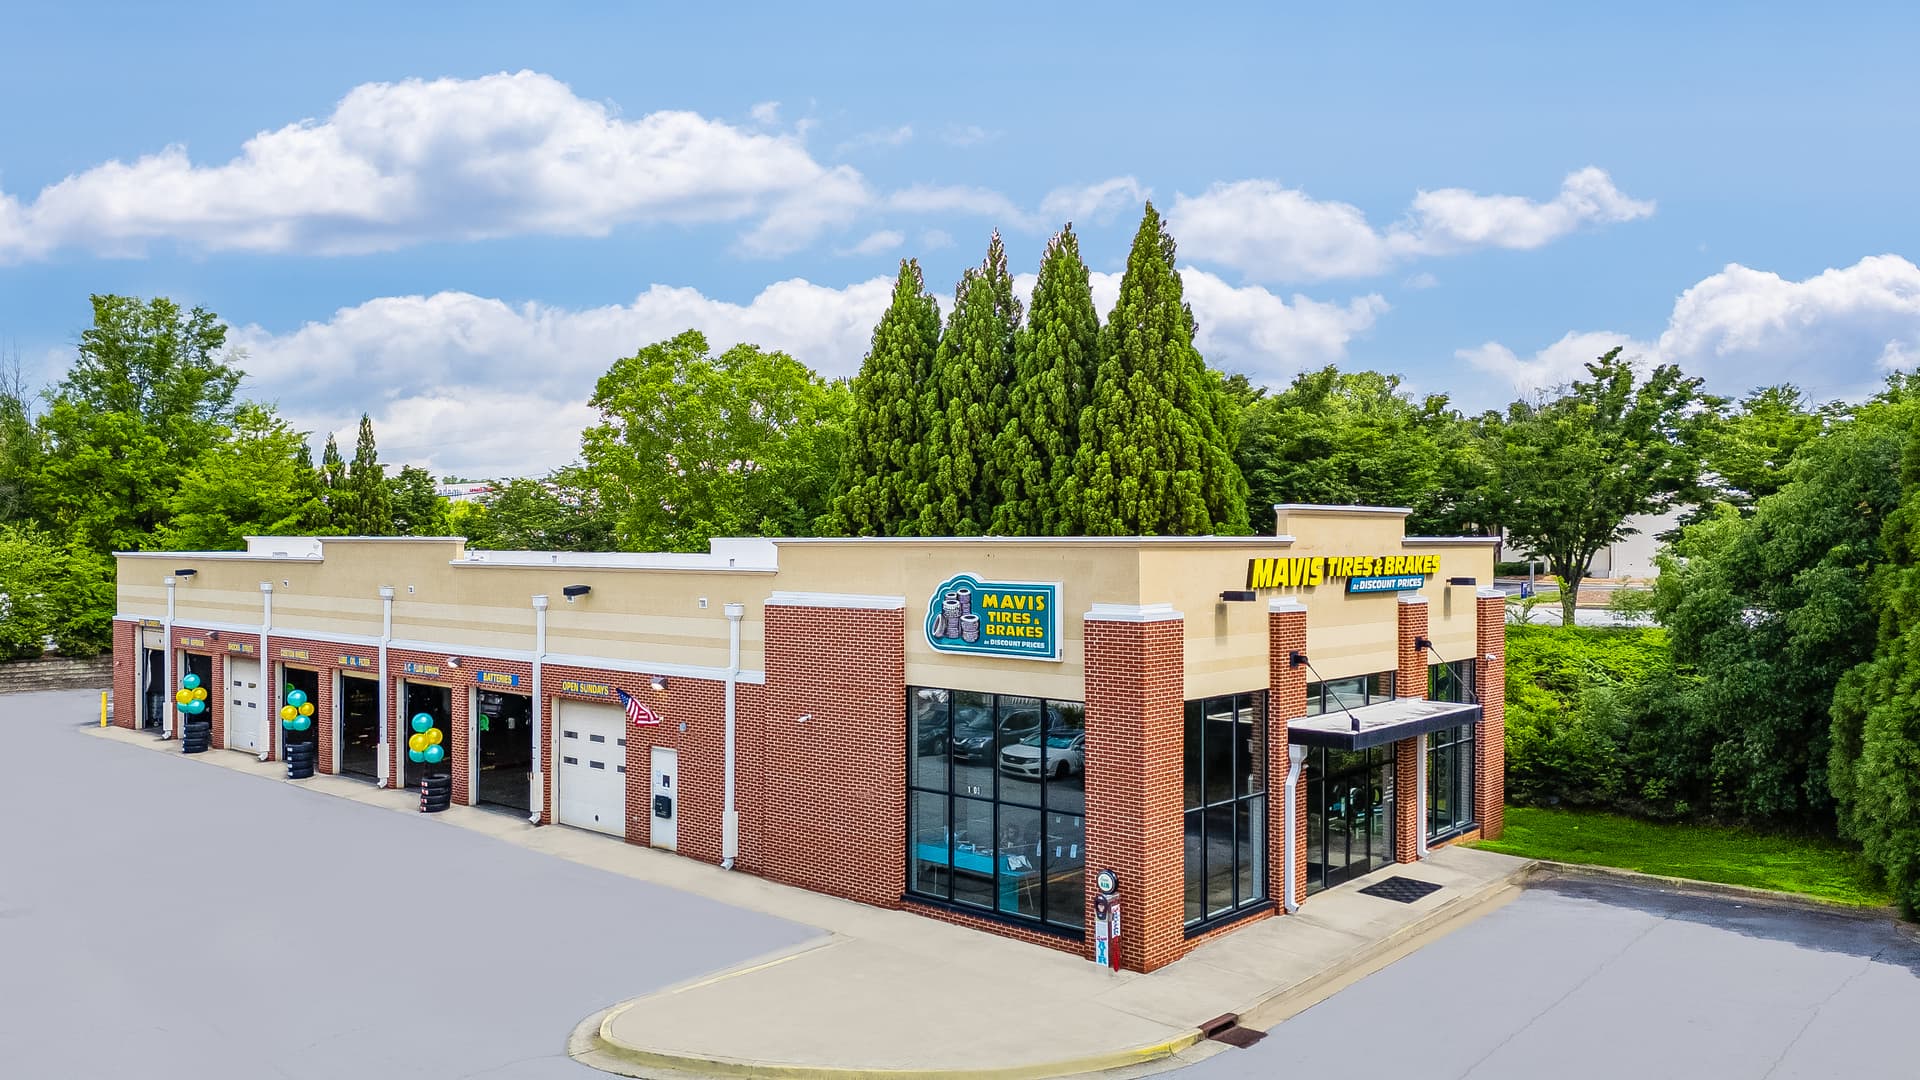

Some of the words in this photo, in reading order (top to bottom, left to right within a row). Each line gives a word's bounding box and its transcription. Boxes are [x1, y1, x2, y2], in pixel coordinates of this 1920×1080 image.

[1252, 557, 1323, 588] MAVIS
[1327, 557, 1374, 577] TIRES
[1374, 557, 1383, 575] &
[1384, 554, 1441, 575] BRAKES
[1359, 580, 1396, 590] DISCOUNT
[1397, 578, 1422, 588] PRICES
[982, 594, 1045, 610] MAVIS
[988, 611, 1031, 624] TIRES
[986, 624, 1043, 638] BRAKES
[990, 639, 1021, 647] DISCOUNT
[1021, 641, 1045, 649] PRICES
[483, 672, 512, 684] BATTERIES
[562, 681, 579, 692] OPEN
[580, 683, 609, 695] SUNDAYS
